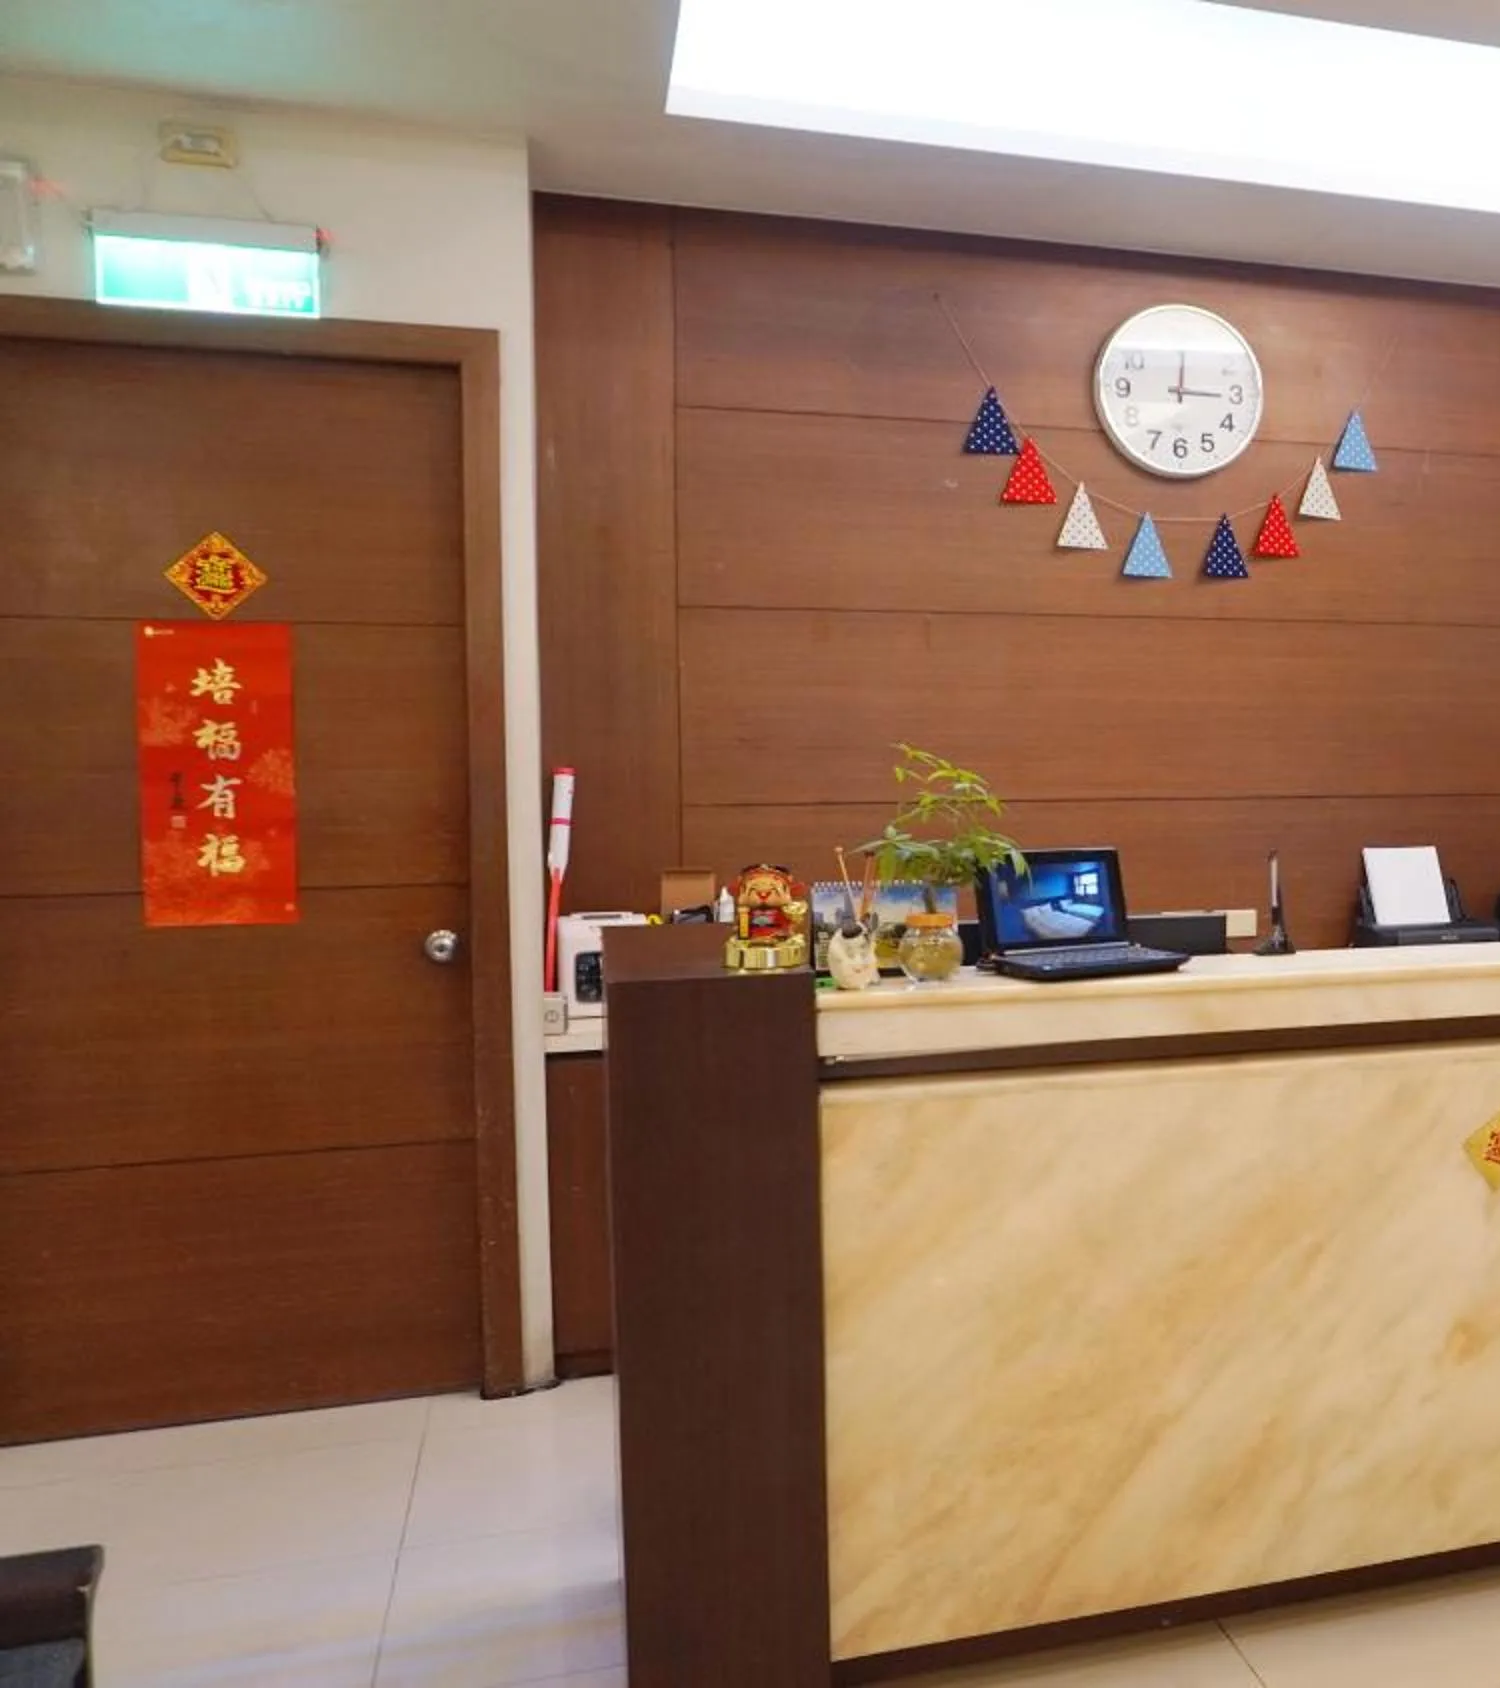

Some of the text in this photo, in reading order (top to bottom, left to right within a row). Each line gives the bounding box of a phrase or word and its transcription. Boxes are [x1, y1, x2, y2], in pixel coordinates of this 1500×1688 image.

[1114, 377, 1131, 398] 9
[1228, 384, 1243, 405] 3
[1125, 406, 1139, 427] 8
[1219, 413, 1236, 432] 4
[1146, 429, 1162, 450] 7
[1173, 437, 1188, 458] 6
[1200, 433, 1215, 453] 5
[190, 657, 246, 877] 培福有福
